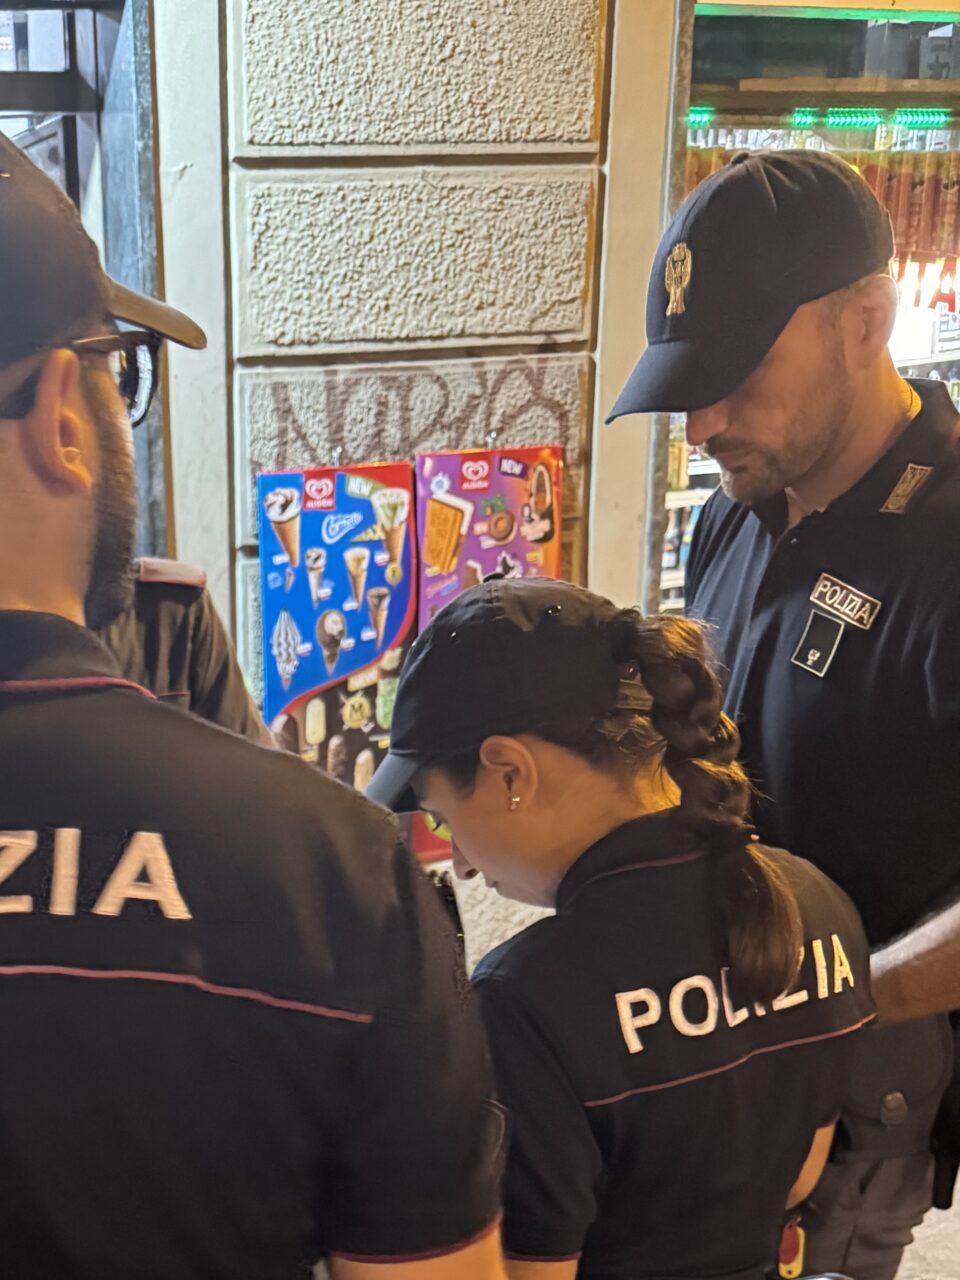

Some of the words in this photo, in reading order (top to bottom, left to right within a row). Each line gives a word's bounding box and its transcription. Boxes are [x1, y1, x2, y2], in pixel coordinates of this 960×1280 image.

[501, 458, 524, 475] NEW
[349, 476, 374, 496] NEW
[814, 580, 871, 624] POLIZIA
[614, 934, 855, 1054] POLIA
